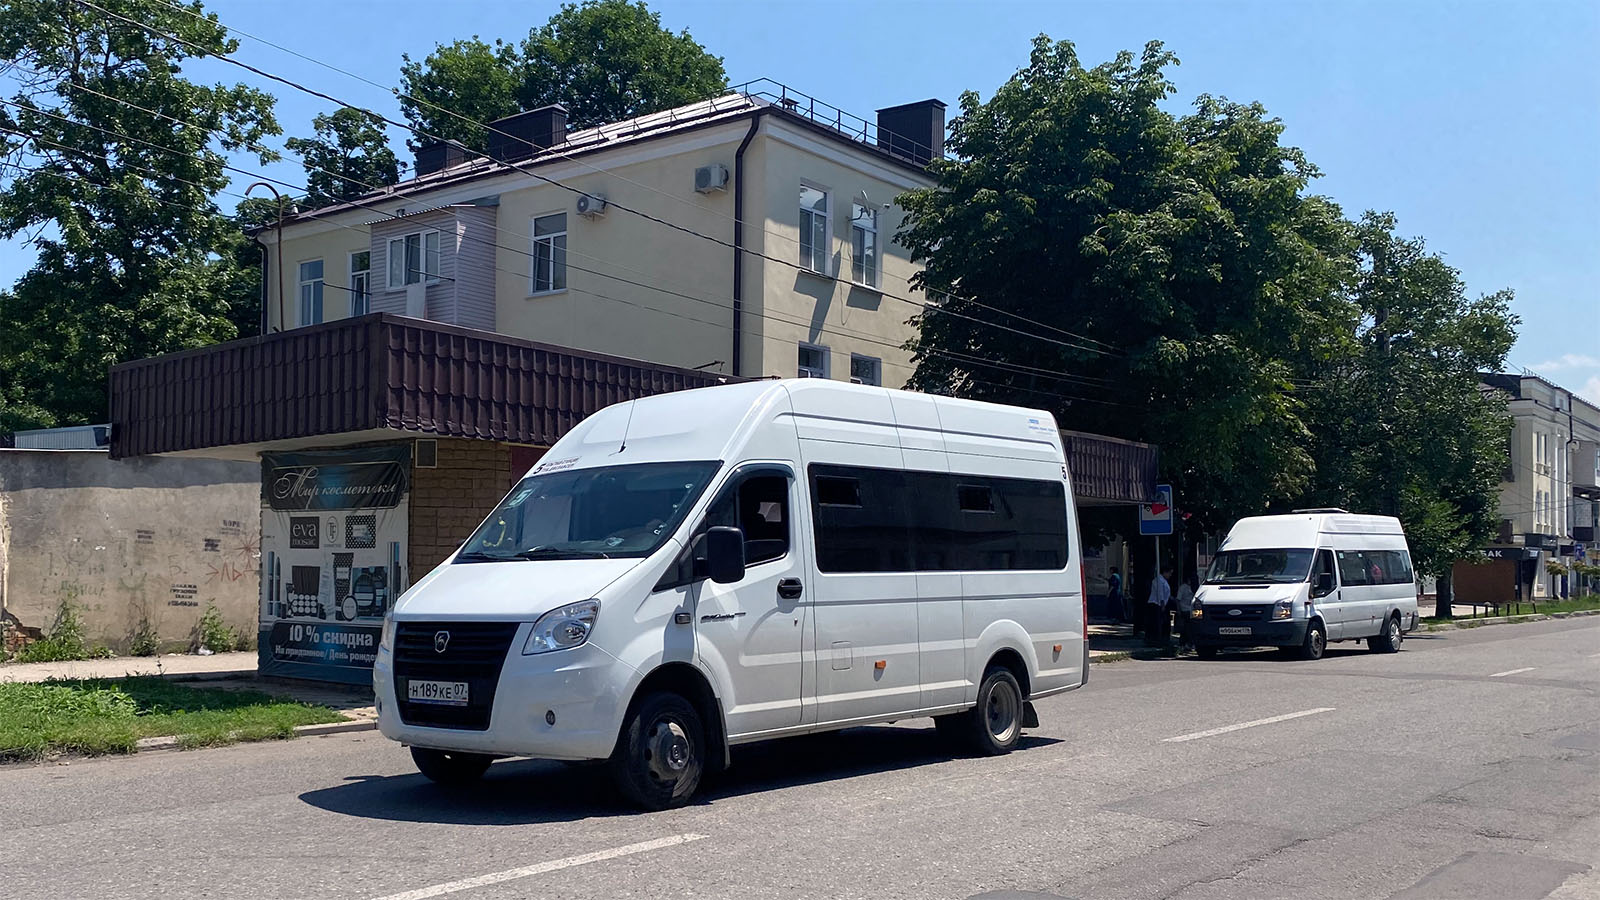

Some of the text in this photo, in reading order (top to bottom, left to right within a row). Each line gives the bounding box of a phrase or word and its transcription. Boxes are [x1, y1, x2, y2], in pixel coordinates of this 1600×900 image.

[1061, 466, 1067, 480] 5
[273, 466, 396, 509] Мир косметики
[292, 523, 317, 537] eva
[289, 624, 303, 642] 10
[306, 625, 320, 643] %
[329, 649, 349, 661] День
[350, 653, 377, 664] рожде
